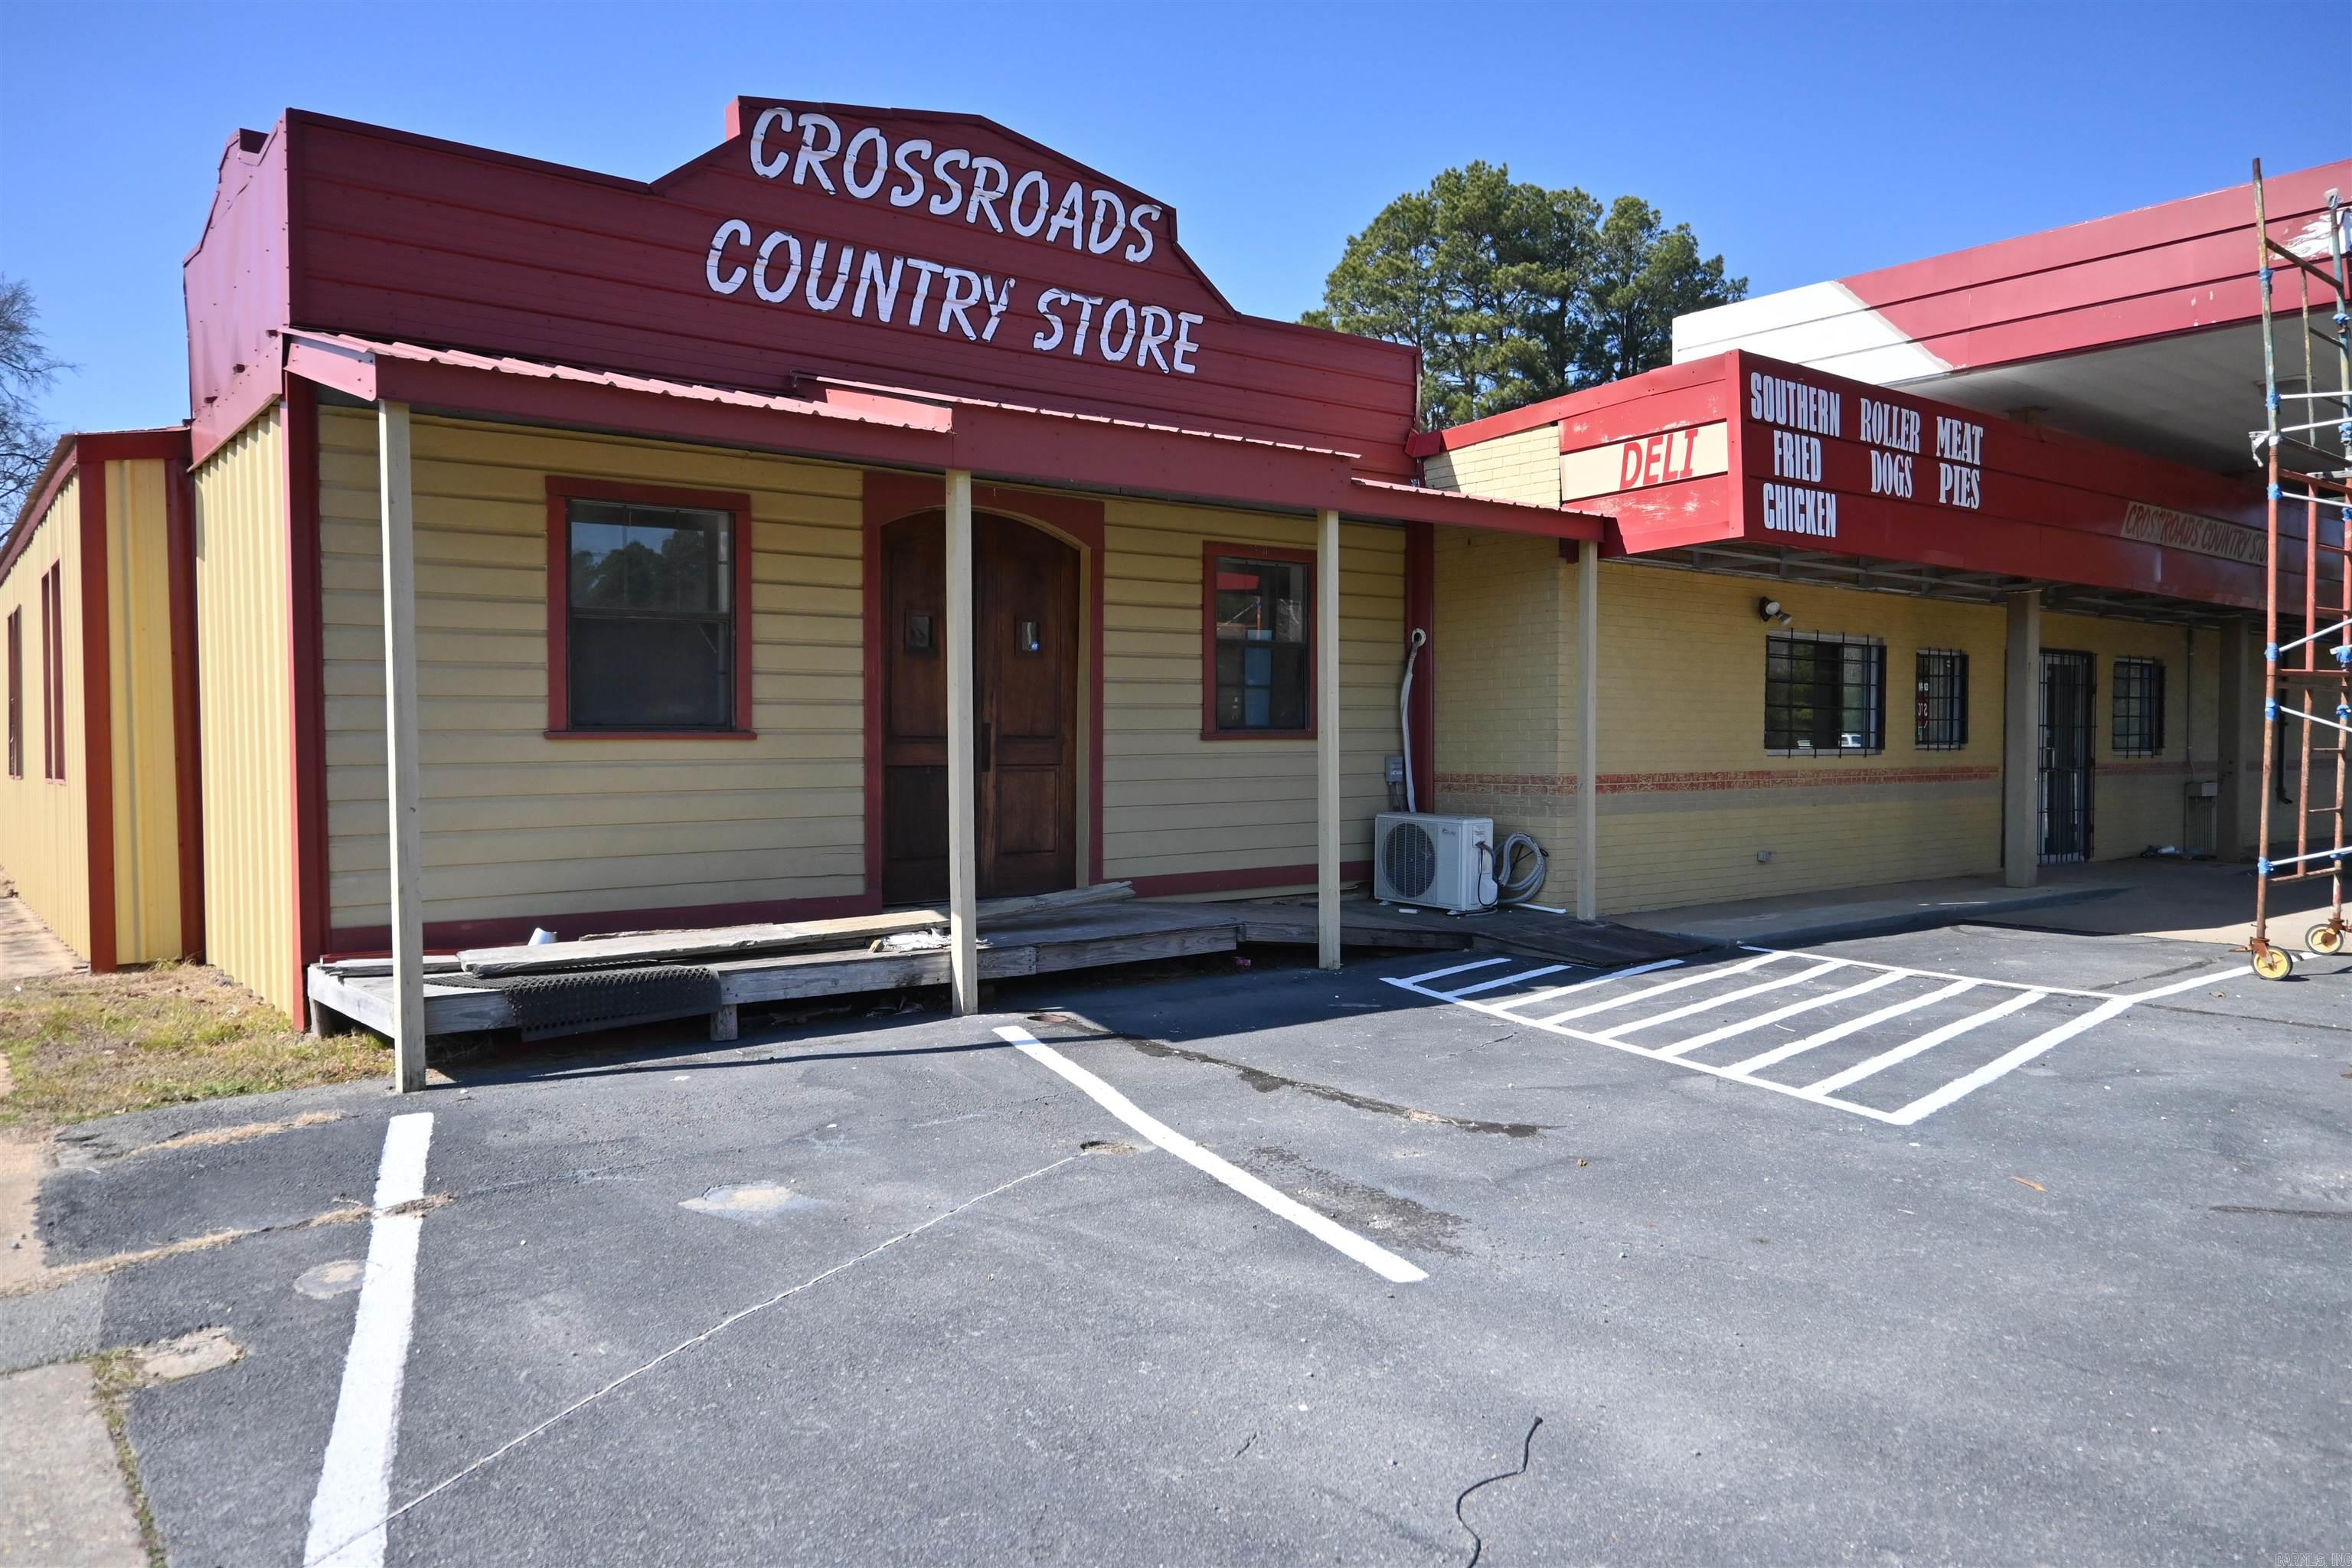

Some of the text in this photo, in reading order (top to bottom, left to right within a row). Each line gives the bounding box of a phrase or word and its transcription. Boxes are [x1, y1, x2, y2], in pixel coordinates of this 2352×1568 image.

[749, 106, 1162, 263] CROSSROADS
[705, 219, 1205, 374] COUNTRY STORE
[1749, 371, 1841, 437] SOUTHERN
[1859, 397, 1921, 454] ROLLER
[1619, 429, 1699, 491] DELI
[1773, 430, 1821, 482] FRIED
[1936, 416, 1984, 466] MEAT
[1870, 449, 1913, 499] DOGS
[1939, 462, 1981, 511] PIES
[1762, 482, 1837, 537] CHICKEN
[2201, 523, 2249, 559] COUNTRY
